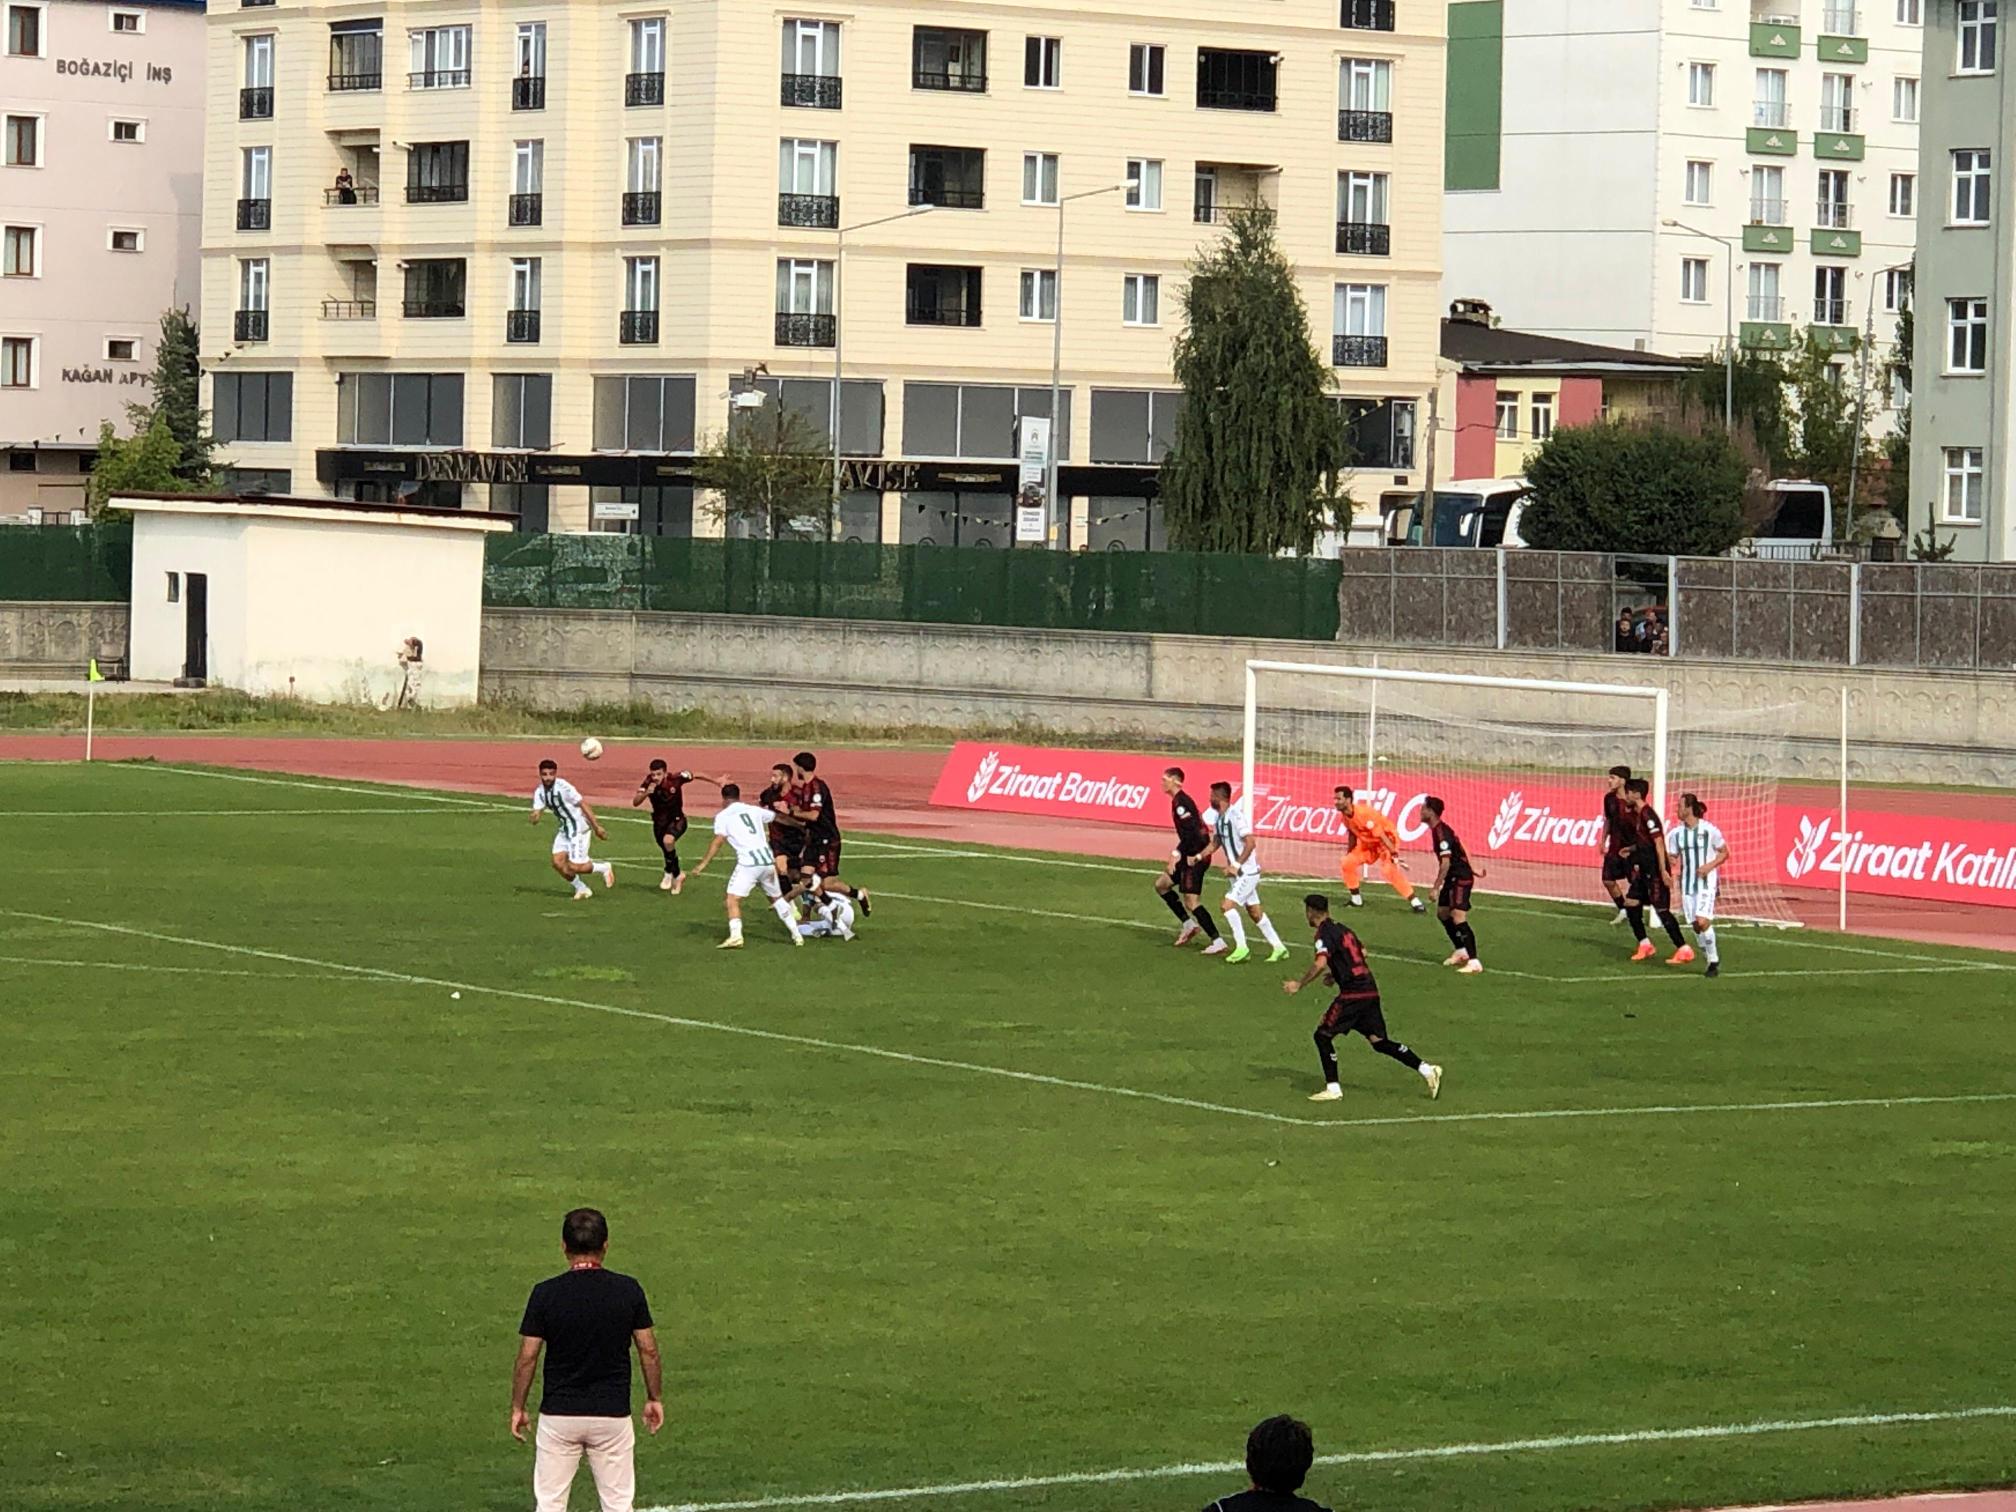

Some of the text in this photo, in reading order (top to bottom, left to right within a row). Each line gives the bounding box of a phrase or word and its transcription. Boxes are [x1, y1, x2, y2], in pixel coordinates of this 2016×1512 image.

[56, 57, 172, 85] BOĞAZİÇİ İNŞ
[61, 363, 113, 384] KAĞAN
[988, 764, 1151, 810] Ziraat Bankası
[739, 813, 757, 834] 9
[1254, 794, 1338, 836] Ziraat
[1514, 806, 1604, 847] Ziraat
[1819, 829, 1934, 881] Ziraat
